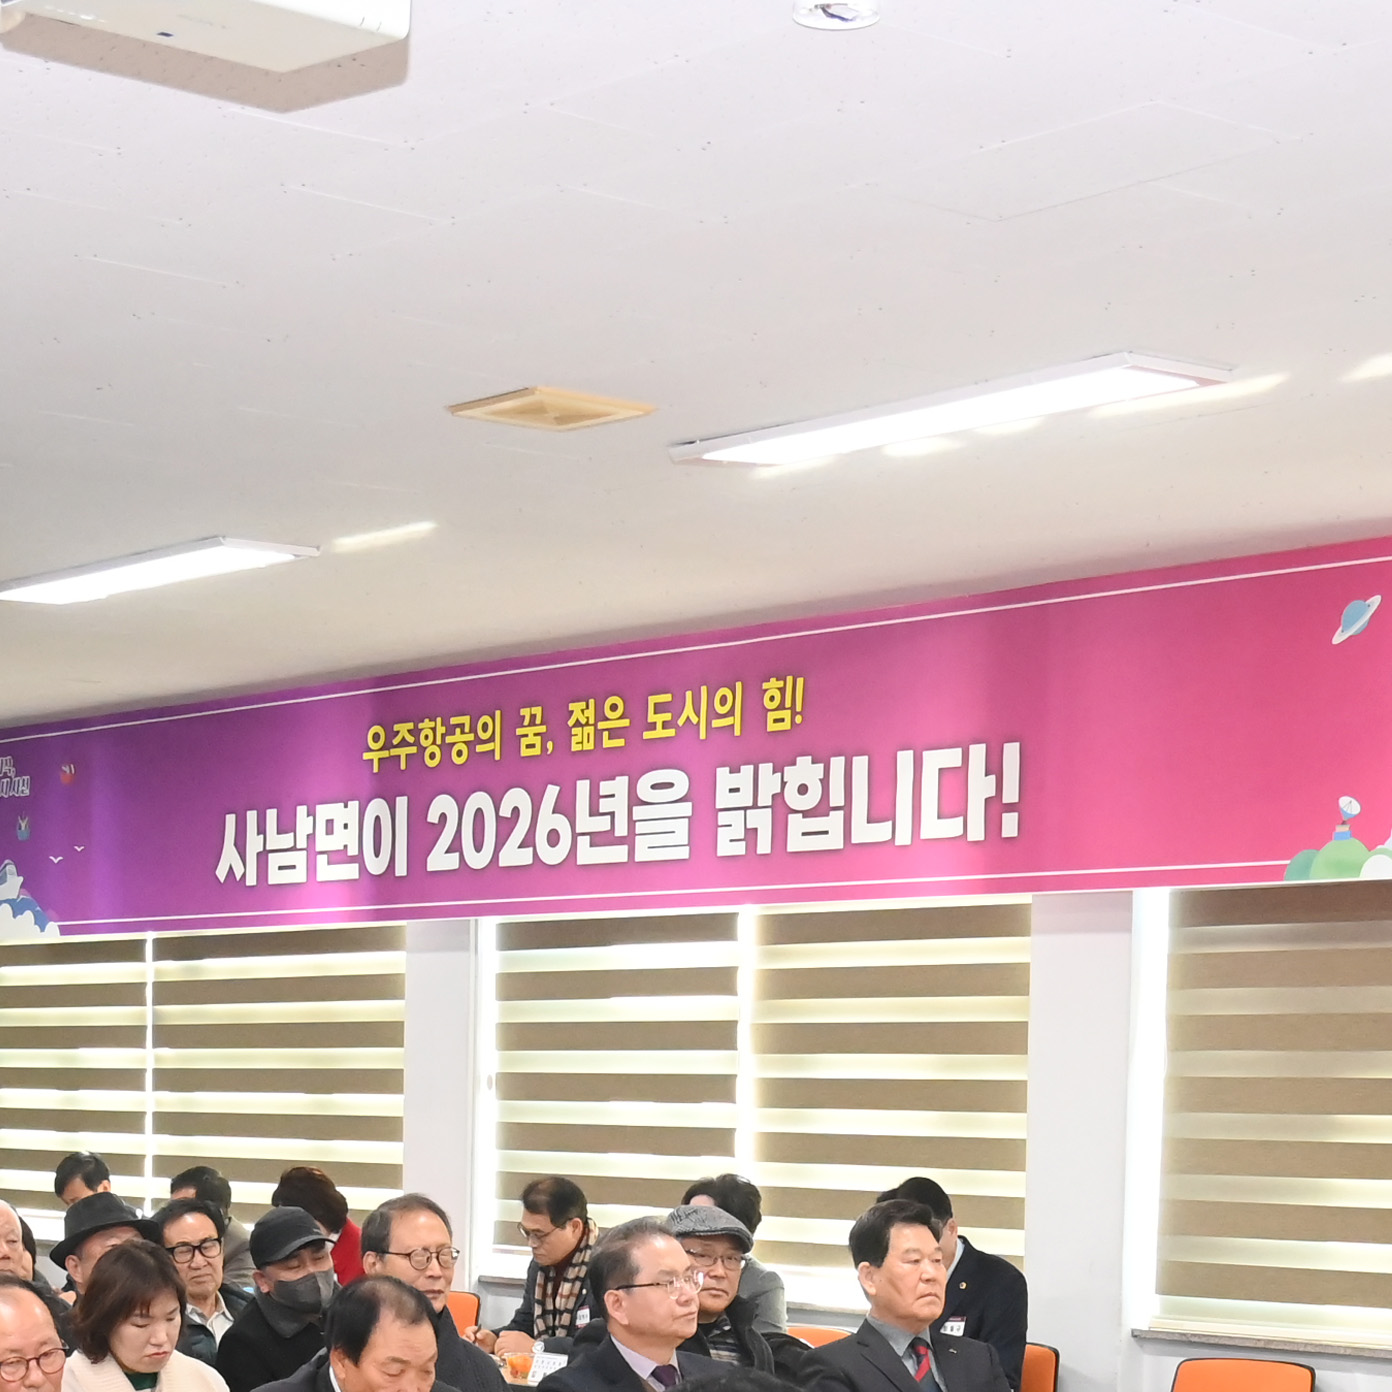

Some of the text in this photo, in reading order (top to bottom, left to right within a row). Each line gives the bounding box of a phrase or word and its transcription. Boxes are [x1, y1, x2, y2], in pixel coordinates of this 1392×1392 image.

[362, 675, 805, 773] 우주항공의 꿈, 젊은 도시의 힘!
[214, 741, 1021, 887] 사남면이 2026년을 밝힙니다!
